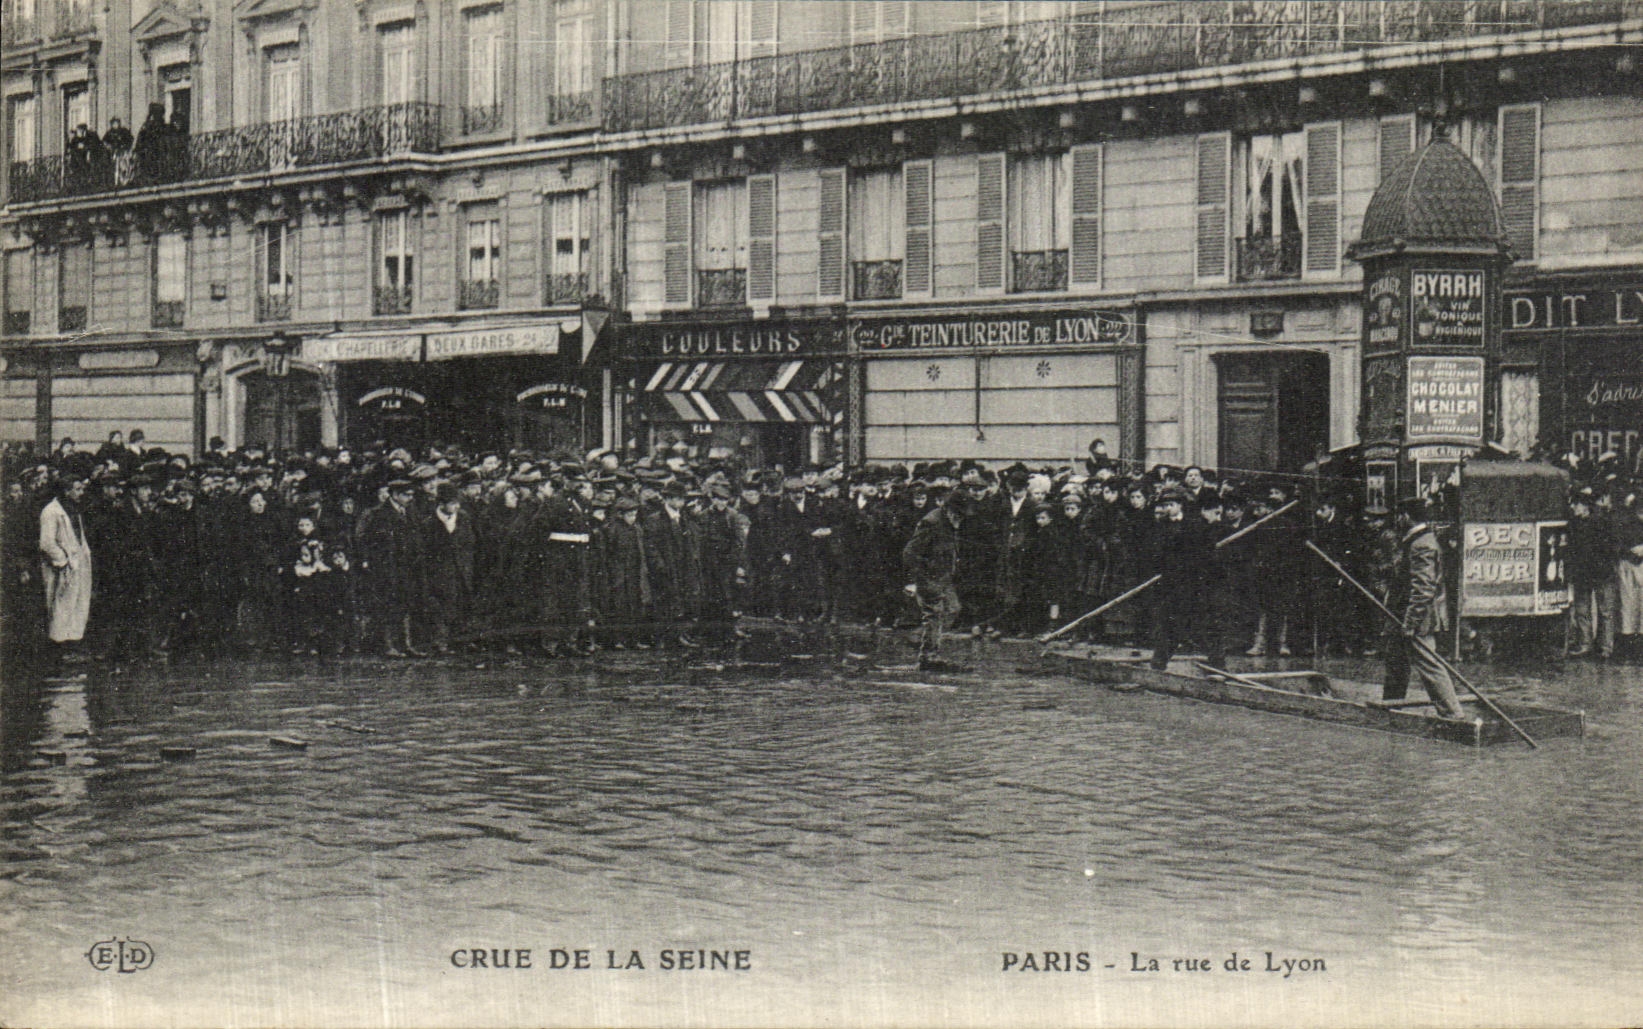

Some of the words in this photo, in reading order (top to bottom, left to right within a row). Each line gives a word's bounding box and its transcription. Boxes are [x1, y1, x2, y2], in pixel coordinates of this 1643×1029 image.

[1414, 274, 1481, 297] BYRRH
[1436, 311, 1482, 322] TONIQUE
[662, 329, 801, 354] COULEURS
[908, 319, 1030, 347] TEINTURERIE
[1034, 325, 1050, 343] DE
[1055, 316, 1101, 343] LYON
[1411, 381, 1480, 396] CHOCOLAT
[1413, 399, 1478, 414] MENIER
[1472, 524, 1531, 547] BEC
